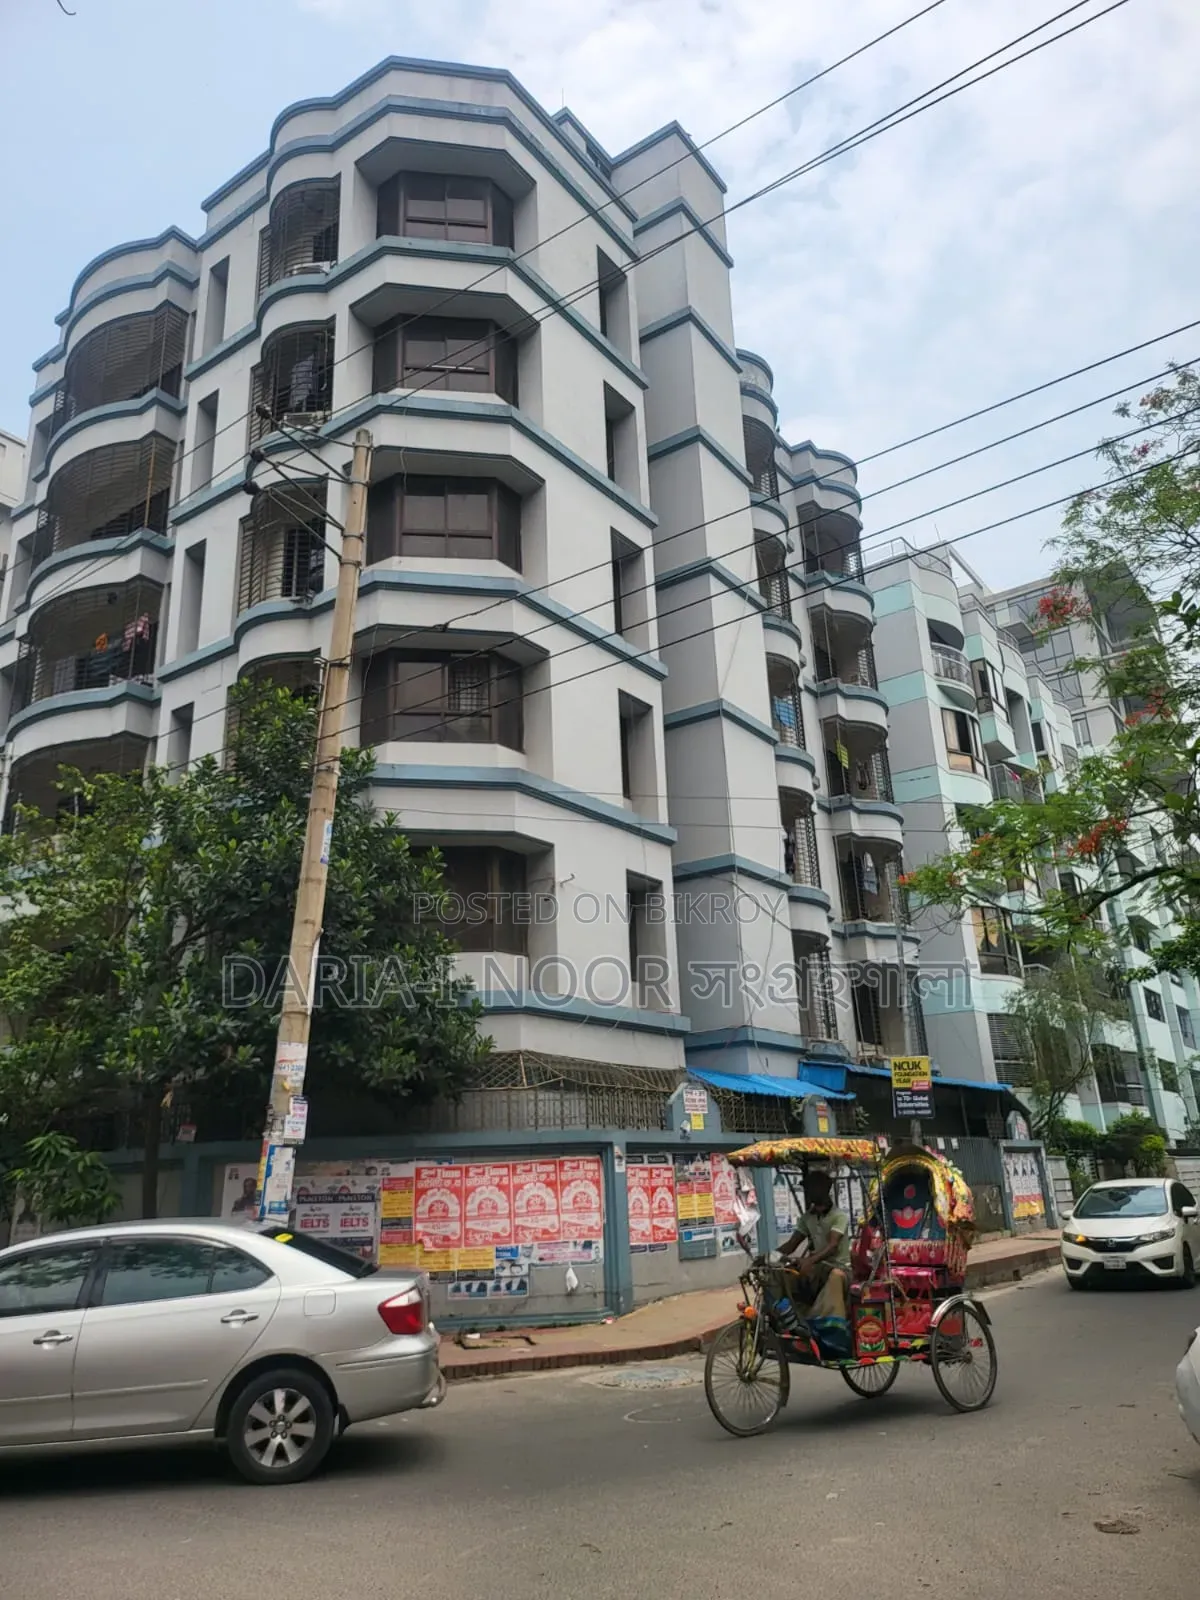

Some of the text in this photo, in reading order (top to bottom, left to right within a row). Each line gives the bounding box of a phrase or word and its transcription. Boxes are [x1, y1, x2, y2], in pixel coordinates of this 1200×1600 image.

[893, 1060, 922, 1071] NCUK
[300, 1218, 330, 1229] IELTS
[340, 1217, 369, 1228] IELTS
